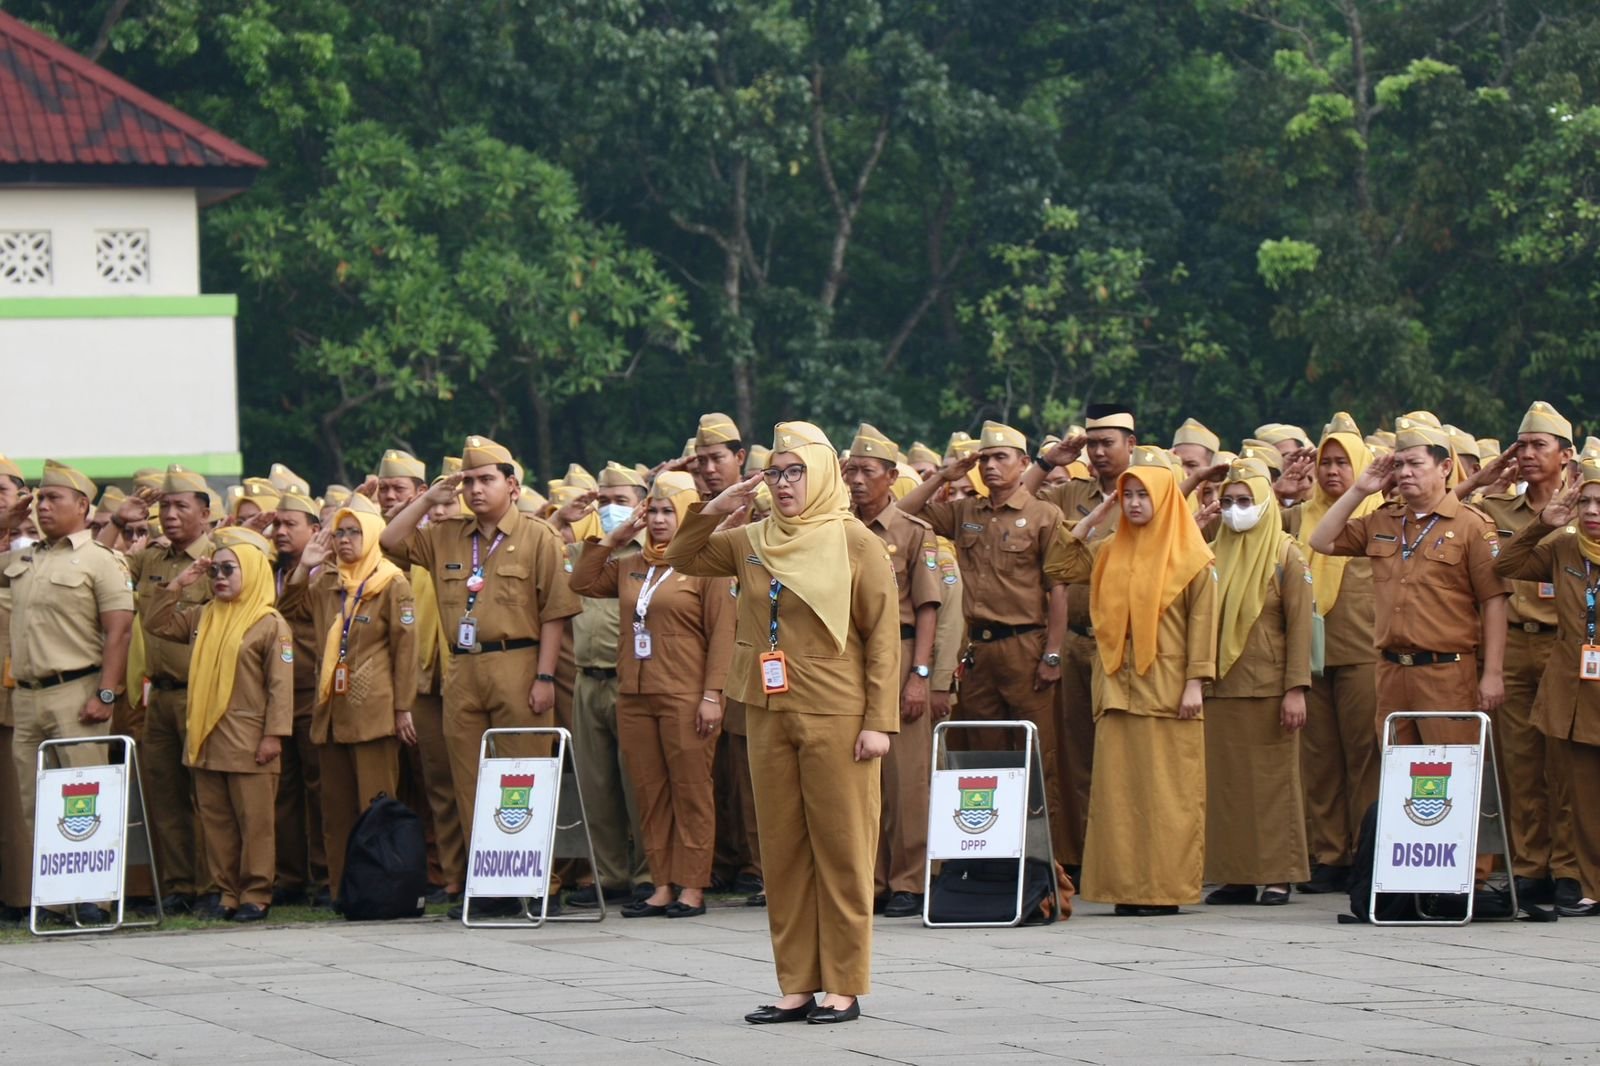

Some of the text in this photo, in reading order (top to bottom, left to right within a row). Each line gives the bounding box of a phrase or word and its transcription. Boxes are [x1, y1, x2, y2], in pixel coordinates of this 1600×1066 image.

[961, 840, 987, 851] DPPP
[1392, 842, 1457, 867] DISDIK
[40, 850, 115, 876] DISPERPUSIP
[473, 850, 542, 877] DISDUKCAPIL
